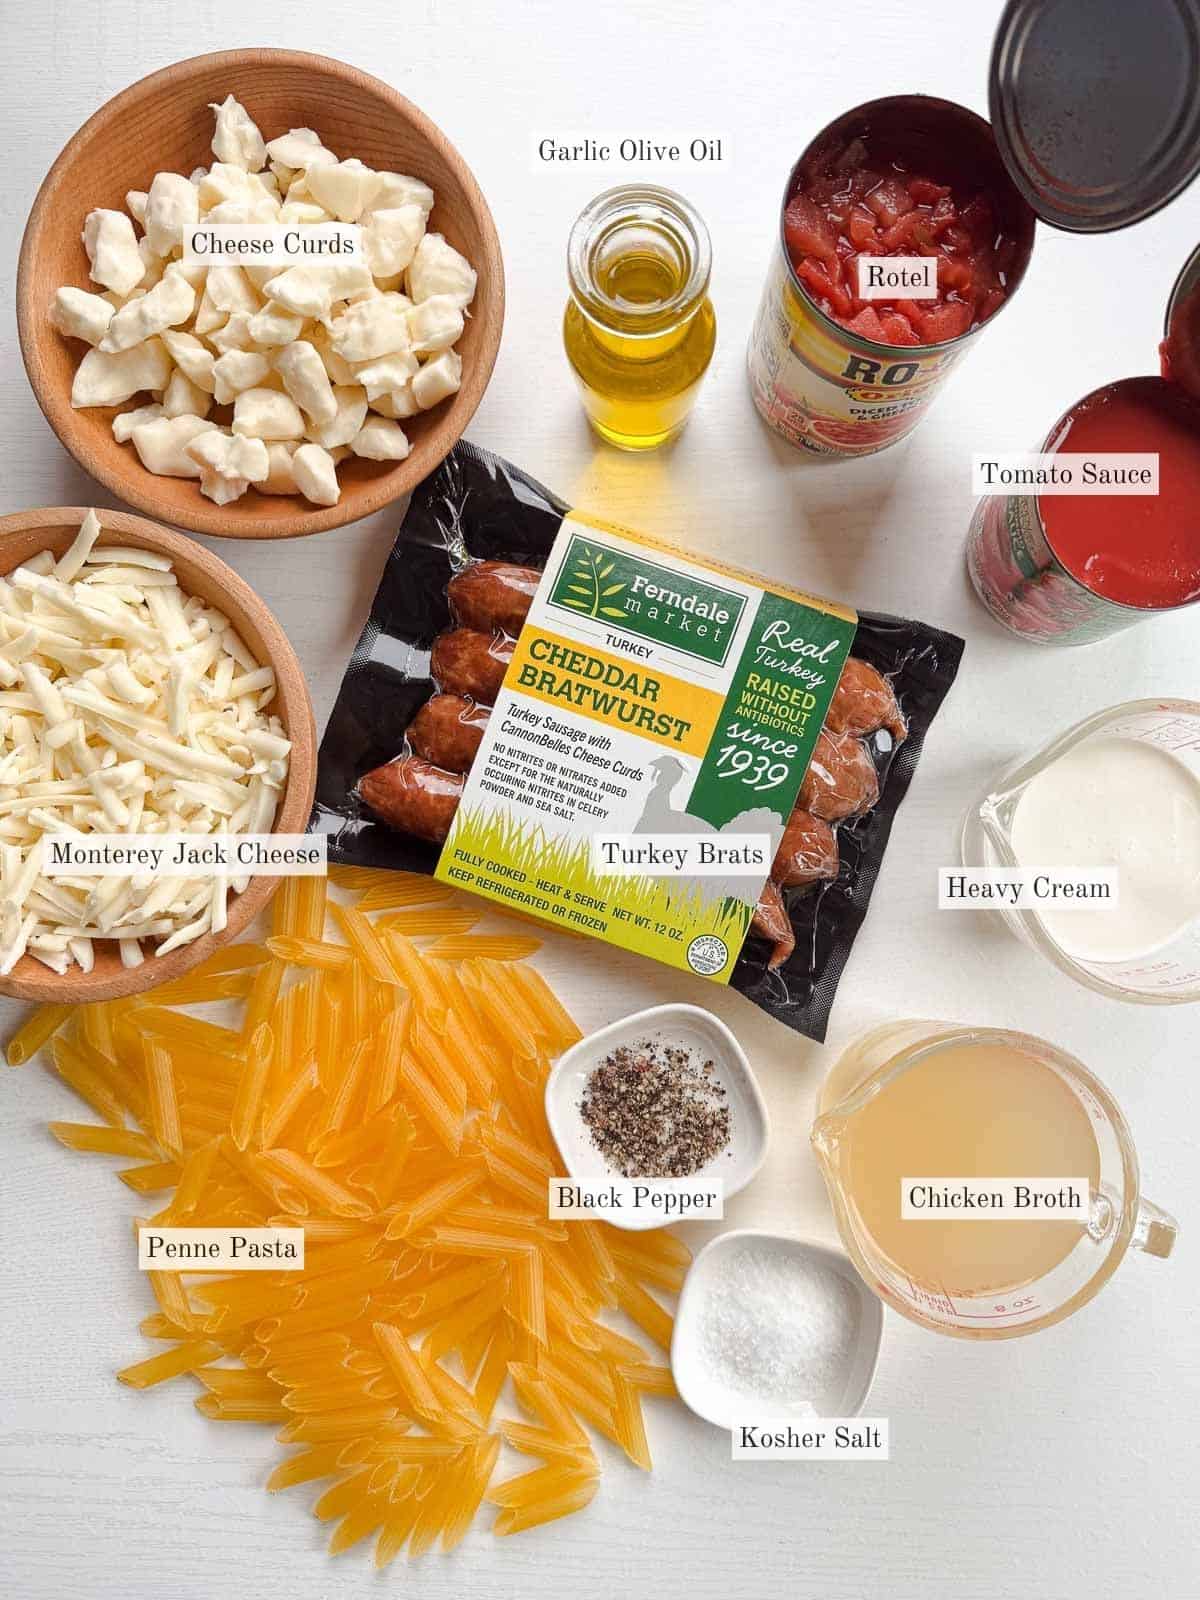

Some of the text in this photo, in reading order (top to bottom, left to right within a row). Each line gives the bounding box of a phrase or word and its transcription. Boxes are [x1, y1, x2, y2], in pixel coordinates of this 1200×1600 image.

[624, 596, 723, 643] market
[630, 575, 729, 625] Ferndale
[605, 633, 654, 659] TURKEY
[761, 620, 840, 664] Real
[529, 638, 661, 702] CHEDDAR
[755, 645, 826, 689] Turkey
[517, 663, 691, 743] BRATWURST
[740, 691, 811, 725] WITHOUT
[746, 672, 817, 710] RAISED
[507, 703, 612, 751] Turkey Sausage with
[728, 722, 798, 758] since
[735, 705, 806, 738] ANTIBIOTICS
[493, 742, 628, 798] NO NITRITES OR NITRATES ADDED
[500, 720, 644, 781] CannonBelles Cheese Curds
[716, 744, 789, 791] 1939
[480, 779, 576, 822] POWDER AND SEA SALT.
[483, 766, 609, 819] OCCURING NITRITES IN CELERY
[488, 754, 604, 803] EXCEPT FOR THE NATURALLY
[447, 866, 608, 933] KEEP REFRIGERATED OR FROZEN
[453, 848, 484, 868] FULLY
[486, 859, 527, 884] COOKED
[535, 879, 562, 897] HEAT
[563, 888, 572, 899] &
[574, 892, 608, 913] SERVE
[612, 906, 684, 942] NET WT. 12 OZ.
